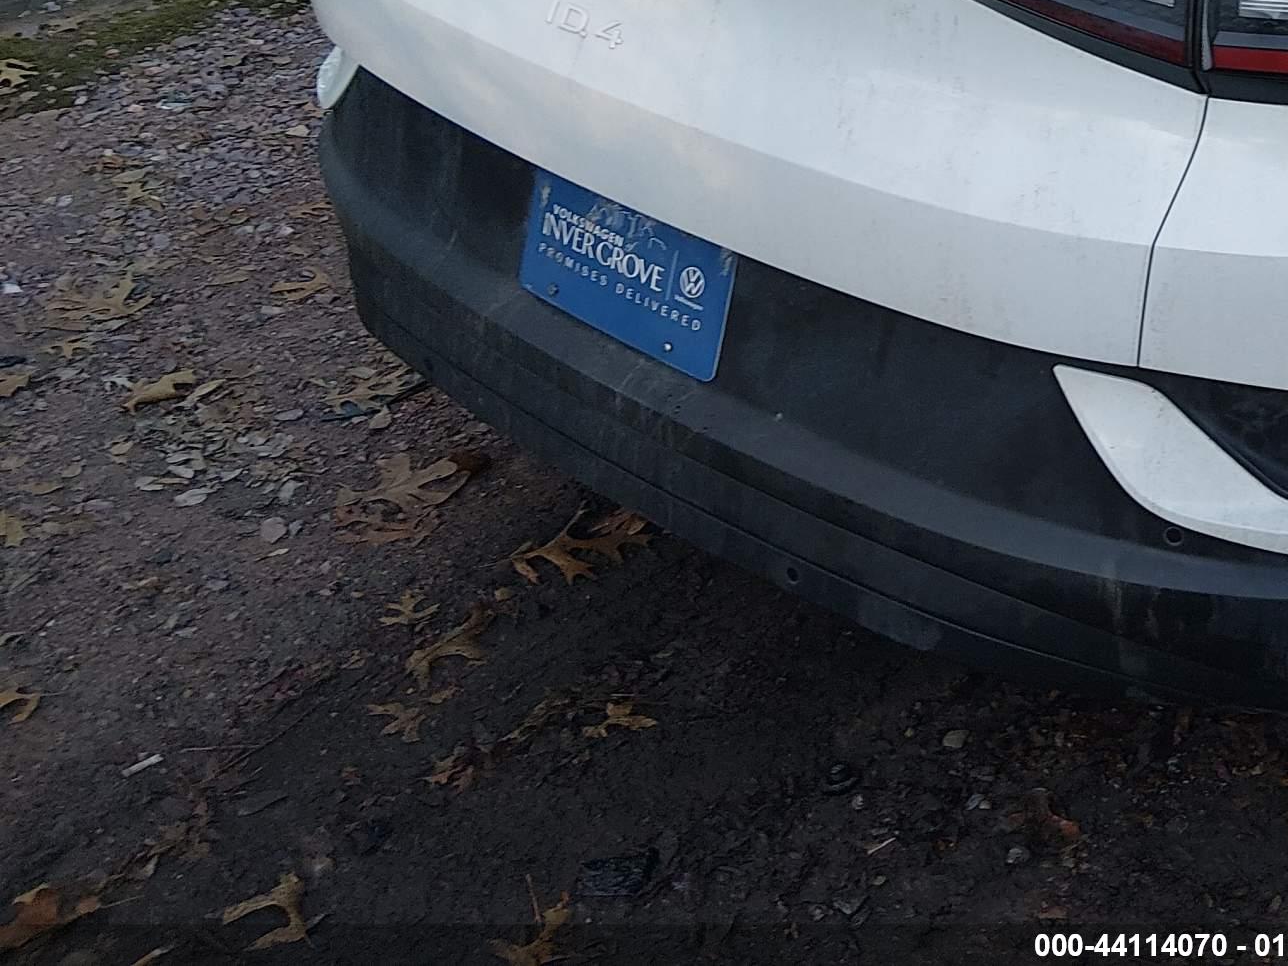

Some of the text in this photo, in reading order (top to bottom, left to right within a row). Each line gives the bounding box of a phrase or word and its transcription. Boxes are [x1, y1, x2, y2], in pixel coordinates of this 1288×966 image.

[542, 212, 665, 292] INVER GROVE
[552, 204, 625, 247] VOLKSWAGEN
[538, 242, 701, 331] PROMISES DELIVERED
